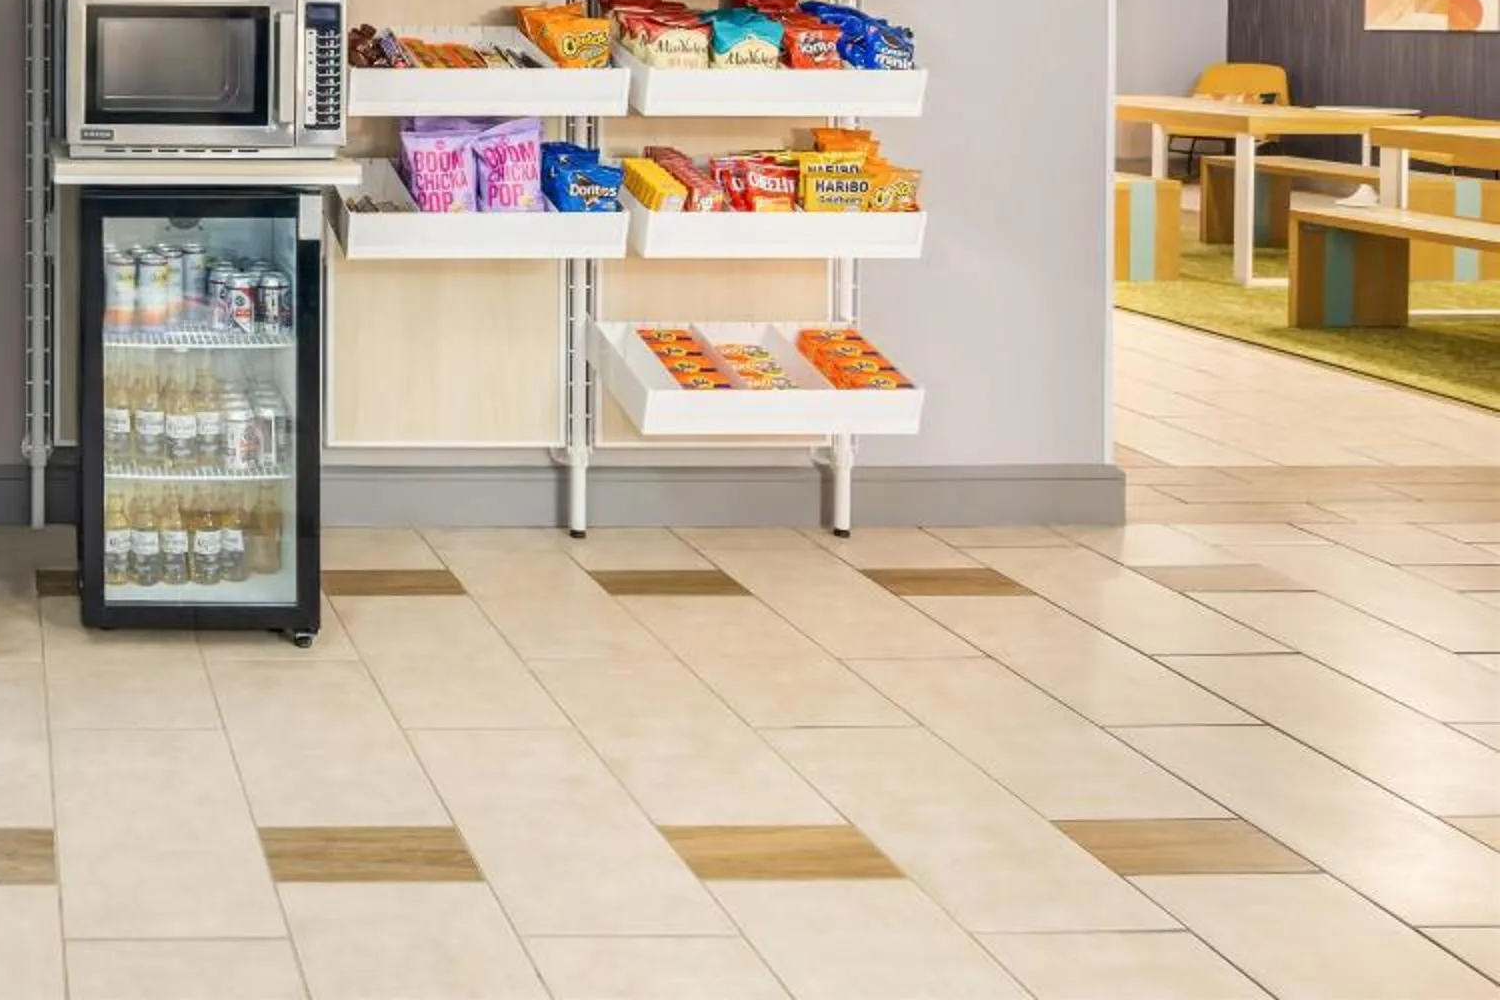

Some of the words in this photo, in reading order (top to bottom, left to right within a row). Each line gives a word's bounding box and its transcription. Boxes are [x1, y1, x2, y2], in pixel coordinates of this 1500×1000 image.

[414, 151, 464, 172] BOOM
[415, 170, 468, 190] CHICKA
[570, 183, 617, 197] Doritos
[815, 180, 869, 193] HARIBO
[417, 191, 453, 212] POP
[488, 184, 524, 208] POP
